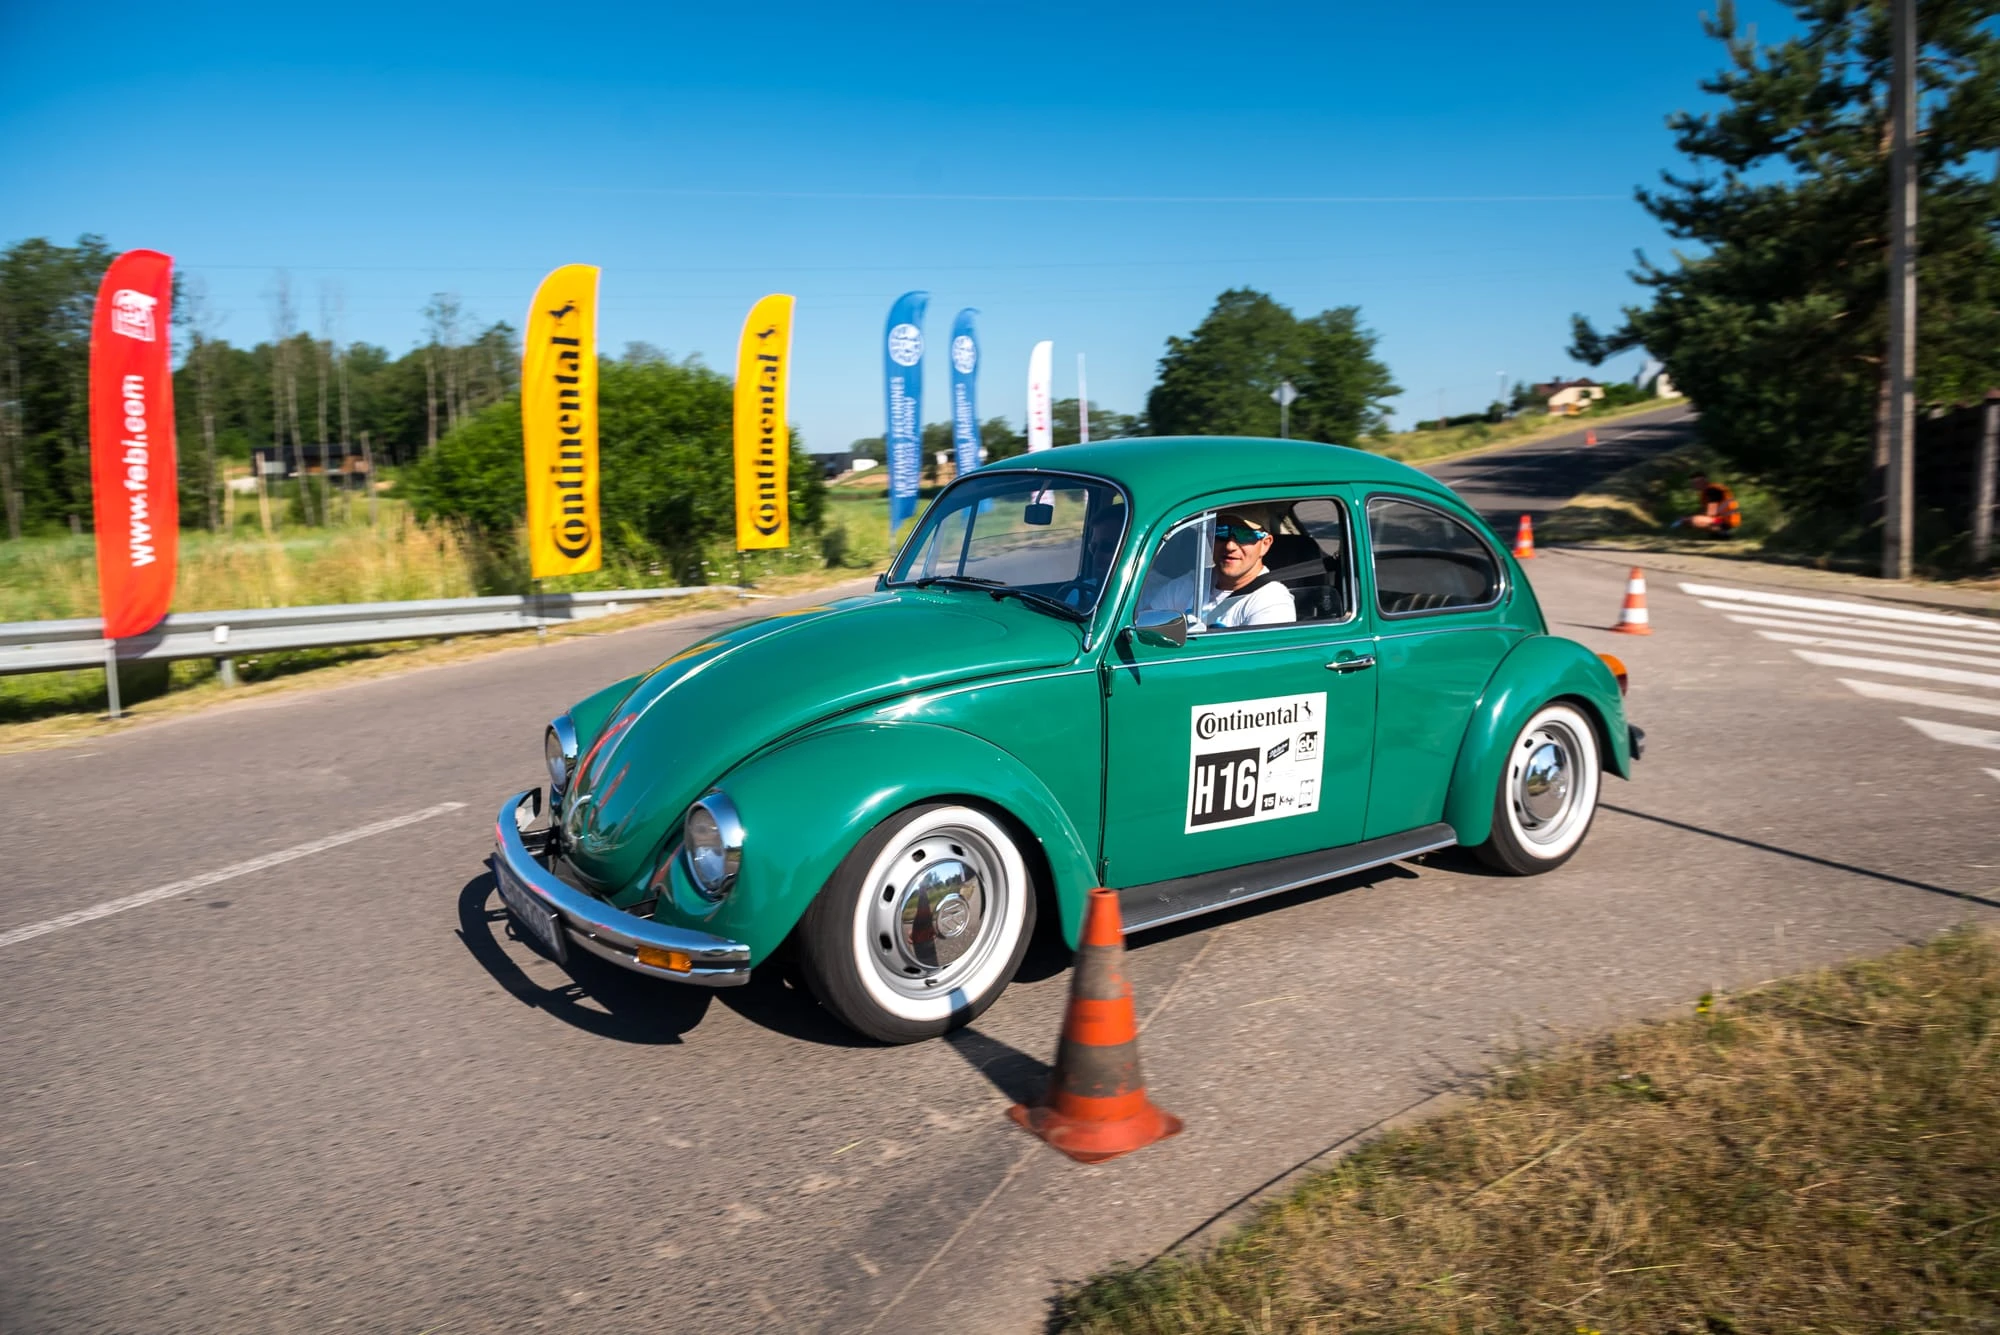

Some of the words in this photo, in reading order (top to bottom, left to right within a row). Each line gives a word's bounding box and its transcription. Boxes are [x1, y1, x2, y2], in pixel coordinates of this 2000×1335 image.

[550, 336, 592, 559] Continental
[753, 354, 781, 536] Continental
[1196, 703, 1299, 740] Continental
